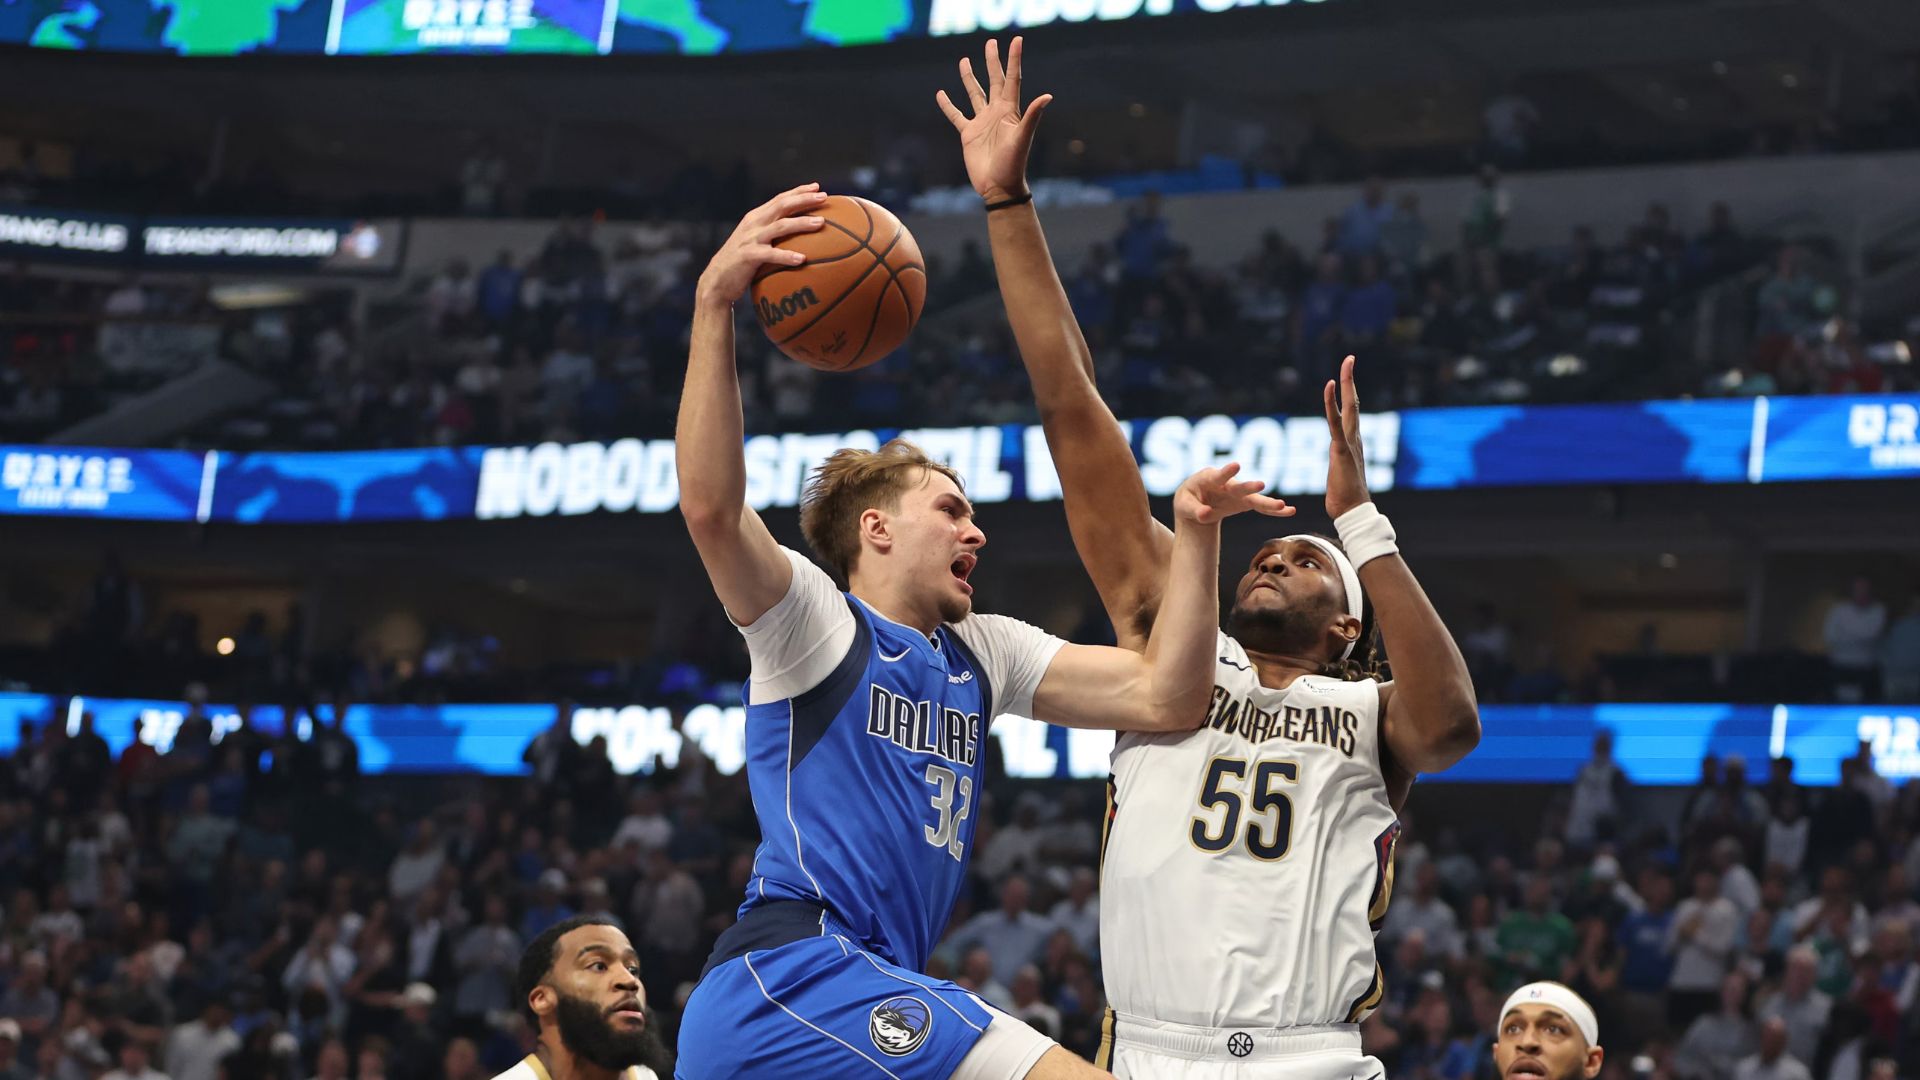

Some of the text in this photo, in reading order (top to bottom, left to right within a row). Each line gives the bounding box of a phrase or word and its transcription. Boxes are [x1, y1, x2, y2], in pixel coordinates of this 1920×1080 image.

[474, 438, 679, 519] NOBOD
[1238, 696, 1359, 760] ORLEANS
[924, 763, 973, 862] 32
[1188, 755, 1300, 863] 55
